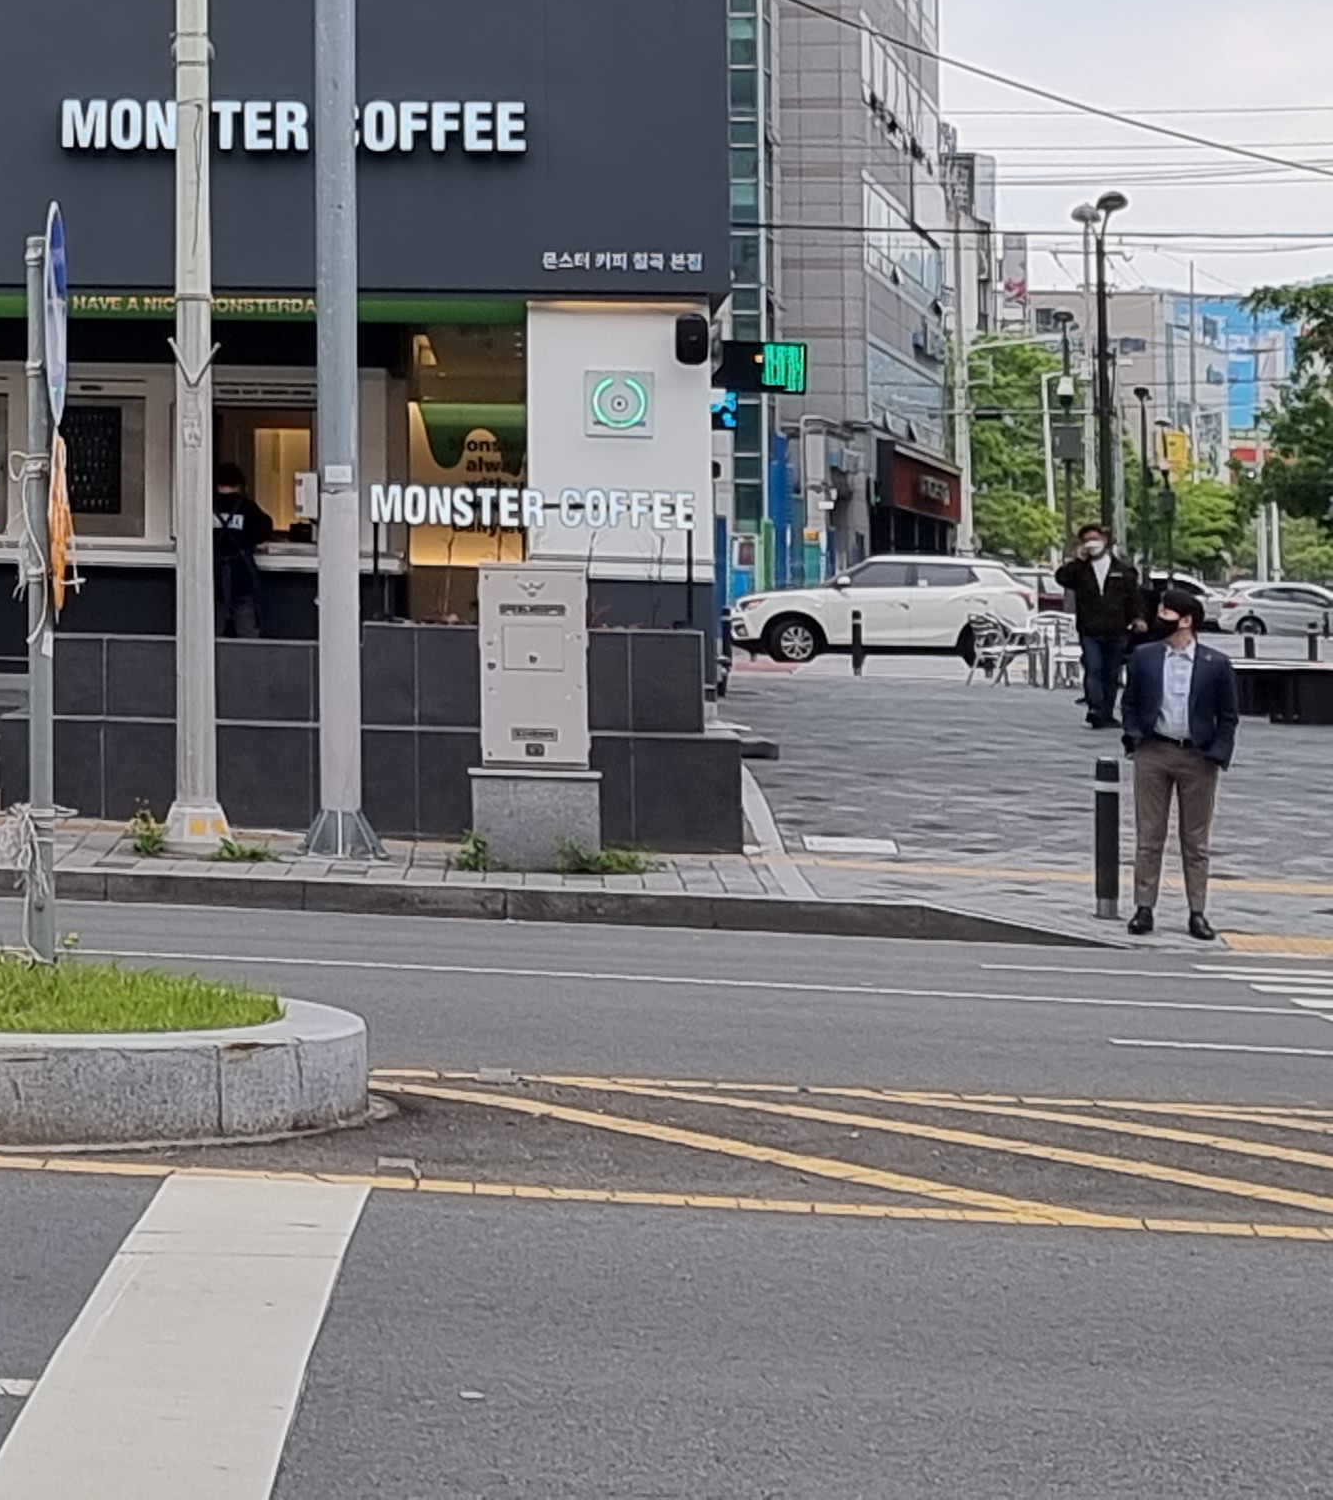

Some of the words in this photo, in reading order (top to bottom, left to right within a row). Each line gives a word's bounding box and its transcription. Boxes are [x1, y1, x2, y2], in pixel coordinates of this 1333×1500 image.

[61, 99, 309, 153] MONTER
[353, 100, 527, 154] OFFEE
[543, 251, 590, 270] 몬스터
[595, 251, 628, 271] 커피
[73, 296, 121, 311] HAVE
[143, 297, 176, 312] NIC
[211, 298, 317, 314] ONSTERDA
[371, 485, 544, 528] MONSTER
[559, 488, 696, 530] COFFEE
